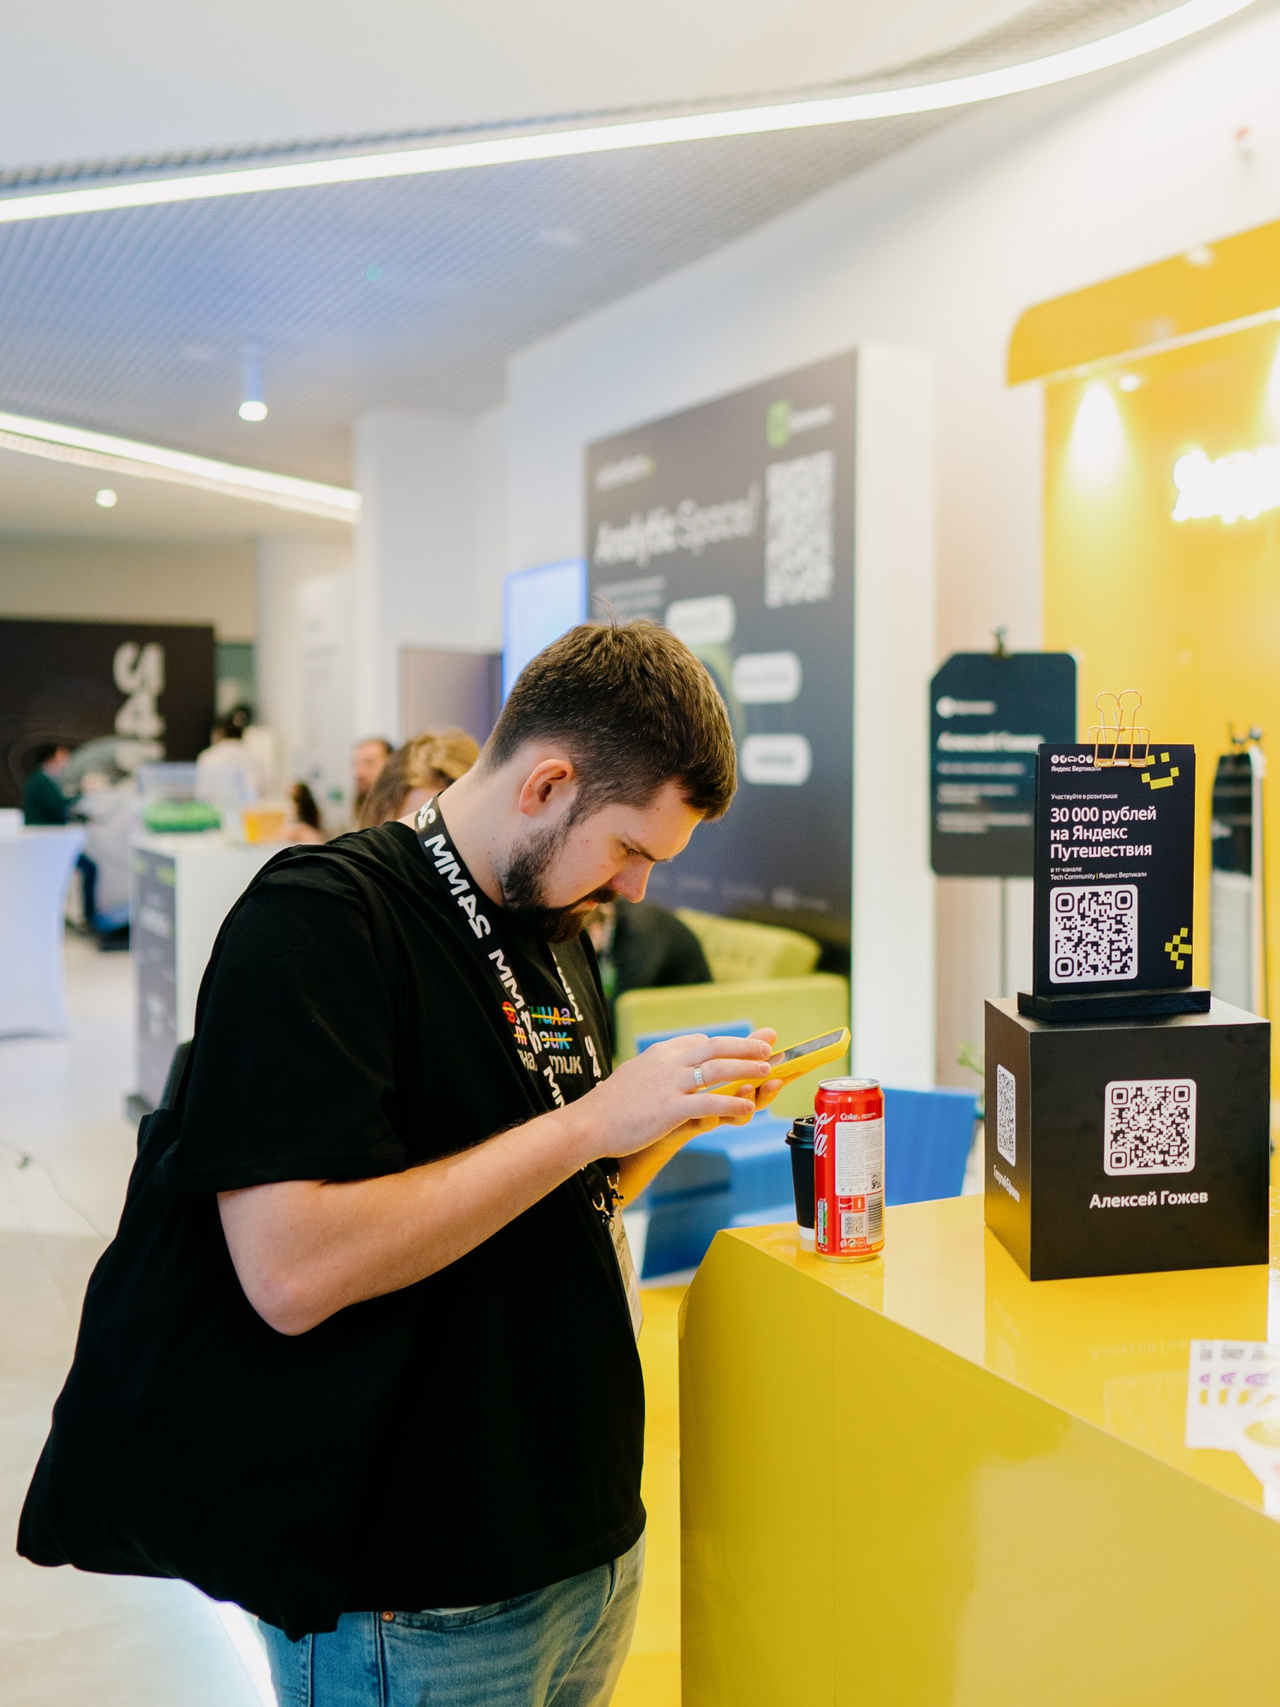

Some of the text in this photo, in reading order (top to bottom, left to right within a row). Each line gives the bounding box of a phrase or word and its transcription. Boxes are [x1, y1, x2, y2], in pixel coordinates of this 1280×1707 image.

[1051, 793, 1082, 801] Участвуйте
[1050, 807, 1070, 823] 30
[1071, 807, 1100, 823] 000
[1102, 806, 1157, 824] рублей
[1050, 825, 1128, 842] на Яндекс
[1050, 844, 1152, 861] Путешествия
[1064, 873, 1095, 881] Community
[1119, 871, 1148, 879] Вертикали
[1088, 1190, 1209, 1209] Алексей Гожев
